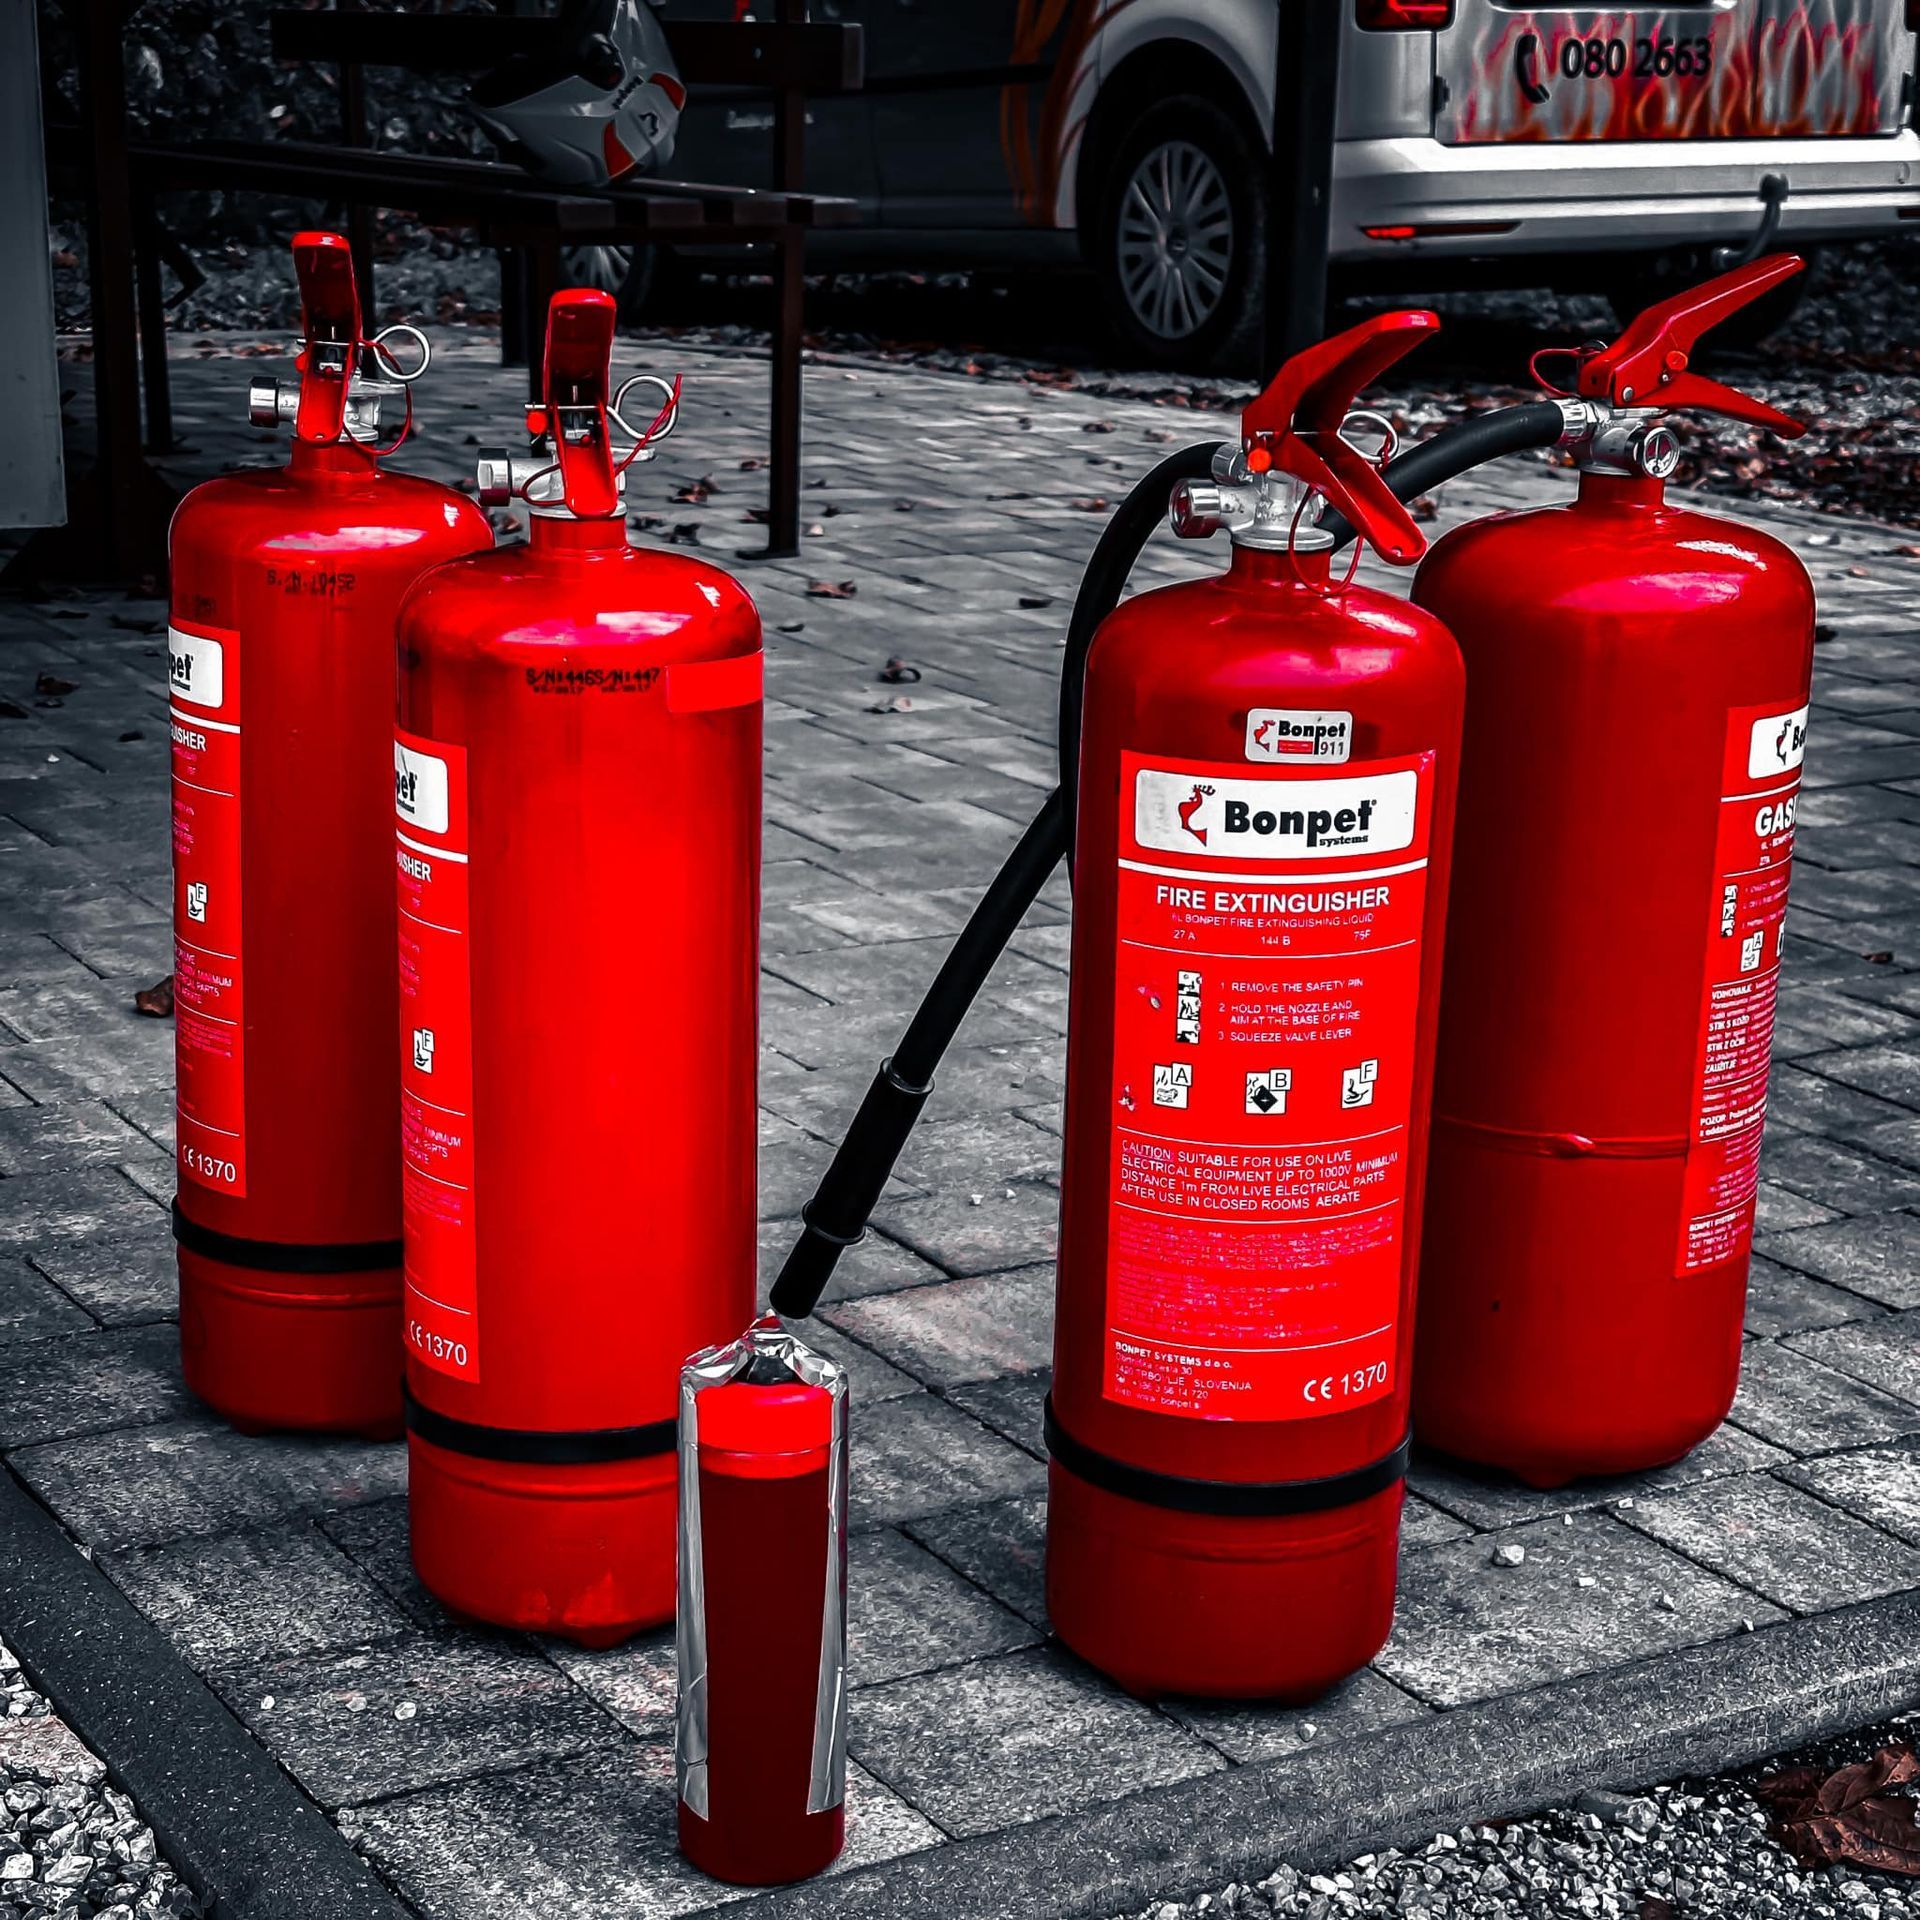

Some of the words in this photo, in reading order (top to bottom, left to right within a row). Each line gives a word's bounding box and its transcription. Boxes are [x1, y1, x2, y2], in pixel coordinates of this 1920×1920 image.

[1560, 37, 1627, 79] 080
[1634, 37, 1712, 79] 2663
[1278, 720, 1346, 755] Bonpet
[1320, 741, 1344, 756] 911
[1319, 834, 1368, 847] systems
[1156, 885, 1207, 910] FIRE
[1214, 886, 1391, 914] EXTINGUISHER
[1185, 913, 1227, 926] BONPET
[1230, 916, 1254, 928] FIRE
[1257, 914, 1341, 929] EXTINGUISHING
[1343, 912, 1374, 925] LIQUID
[1231, 981, 1278, 994] REMOVE
[1282, 981, 1302, 993] THE
[1305, 978, 1344, 993] SAFETY
[1348, 977, 1363, 988] PIN
[1231, 1004, 1261, 1015] HOLD
[1264, 1003, 1285, 1014] THE
[1288, 1001, 1330, 1014] NOZZLE
[1331, 999, 1353, 1012] AND
[1229, 1013, 1250, 1025] AIM
[1251, 1014, 1265, 1025] AT
[1267, 1015, 1289, 1026] THE
[1292, 1013, 1320, 1025] BASE
[1322, 1012, 1336, 1024] OF
[1339, 1010, 1361, 1022] FIRE
[1230, 1031, 1281, 1043] SQUEEZE
[1284, 1030, 1316, 1043] VALVE
[1319, 1027, 1352, 1040] LEVER
[1175, 1067, 1188, 1084] A
[1275, 1072, 1287, 1088] B
[1363, 1063, 1374, 1080] F
[1121, 1153, 1190, 1178] ELECTRICAL
[1194, 1167, 1272, 1182] EQUIPMENT
[1276, 1171, 1294, 1182] UP
[1298, 1169, 1315, 1180] TO
[1319, 1164, 1352, 1179] 1000V
[1356, 1151, 1398, 1173] MINIMUM
[1178, 1151, 1239, 1167] SUITABLE
[1243, 1156, 1271, 1168] FOR
[1275, 1155, 1302, 1168] USE
[1305, 1154, 1324, 1166] ON
[1326, 1150, 1352, 1164] LIVE
[197, 1153, 236, 1183] 1370
[1121, 1167, 1176, 1190] DISTANCE
[1181, 1181, 1197, 1192] 1m
[1201, 1182, 1239, 1195] FROM
[1243, 1185, 1272, 1197] LIVE
[1275, 1180, 1350, 1197] ELECTRICAL
[1353, 1170, 1385, 1187] PARTS
[1121, 1182, 1155, 1200] AFTER
[1159, 1191, 1183, 1205] USE
[1188, 1196, 1199, 1207] IN
[1203, 1196, 1258, 1210] CLOSED
[1261, 1198, 1310, 1210] ROOMS
[1316, 1190, 1360, 1207] AERATE
[425, 1332, 467, 1366] 1370
[1115, 1341, 1151, 1358] BONPET
[1154, 1351, 1201, 1367] SYSTEMS
[1193, 1379, 1252, 1391] SLOVENIJA
[1341, 1360, 1387, 1395] 1370
[1191, 1389, 1208, 1399] 720
